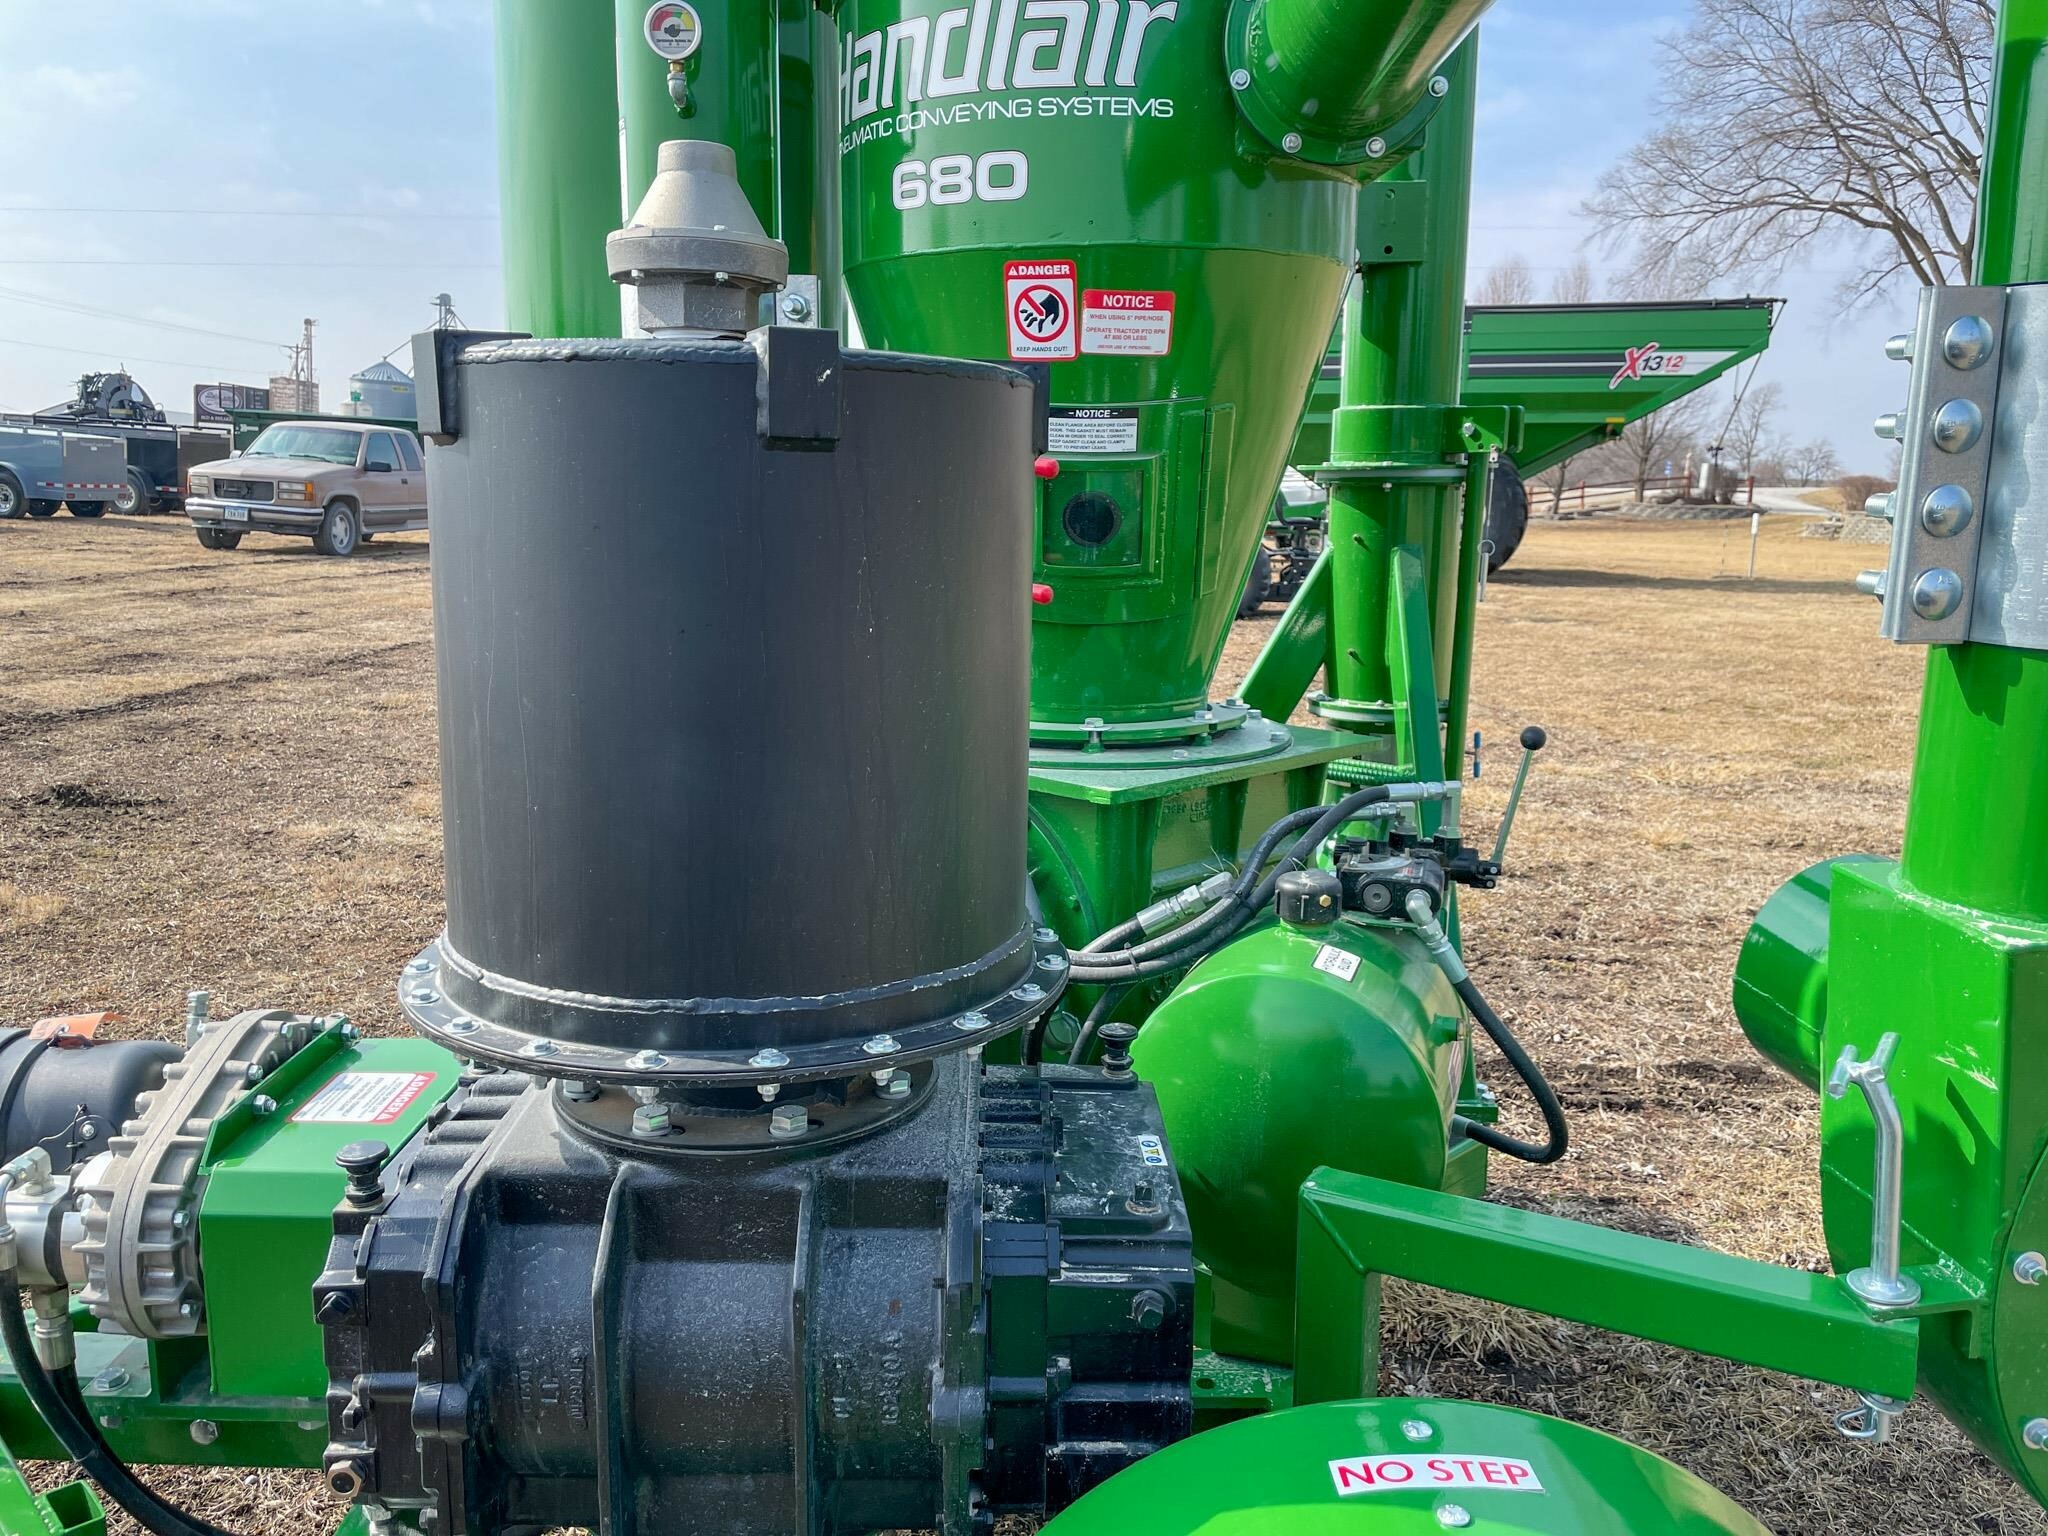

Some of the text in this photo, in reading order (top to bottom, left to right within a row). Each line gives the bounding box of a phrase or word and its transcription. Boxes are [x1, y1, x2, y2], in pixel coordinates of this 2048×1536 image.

[896, 98, 1032, 133] CONVEYING
[1038, 96, 1174, 118] SYSTEMS
[892, 149, 1029, 211] 680
[1018, 264, 1071, 276] DANGER
[1102, 294, 1155, 308] NOTICE
[1075, 409, 1111, 418] NOTICE
[1337, 1459, 1529, 1488] NO STEP
